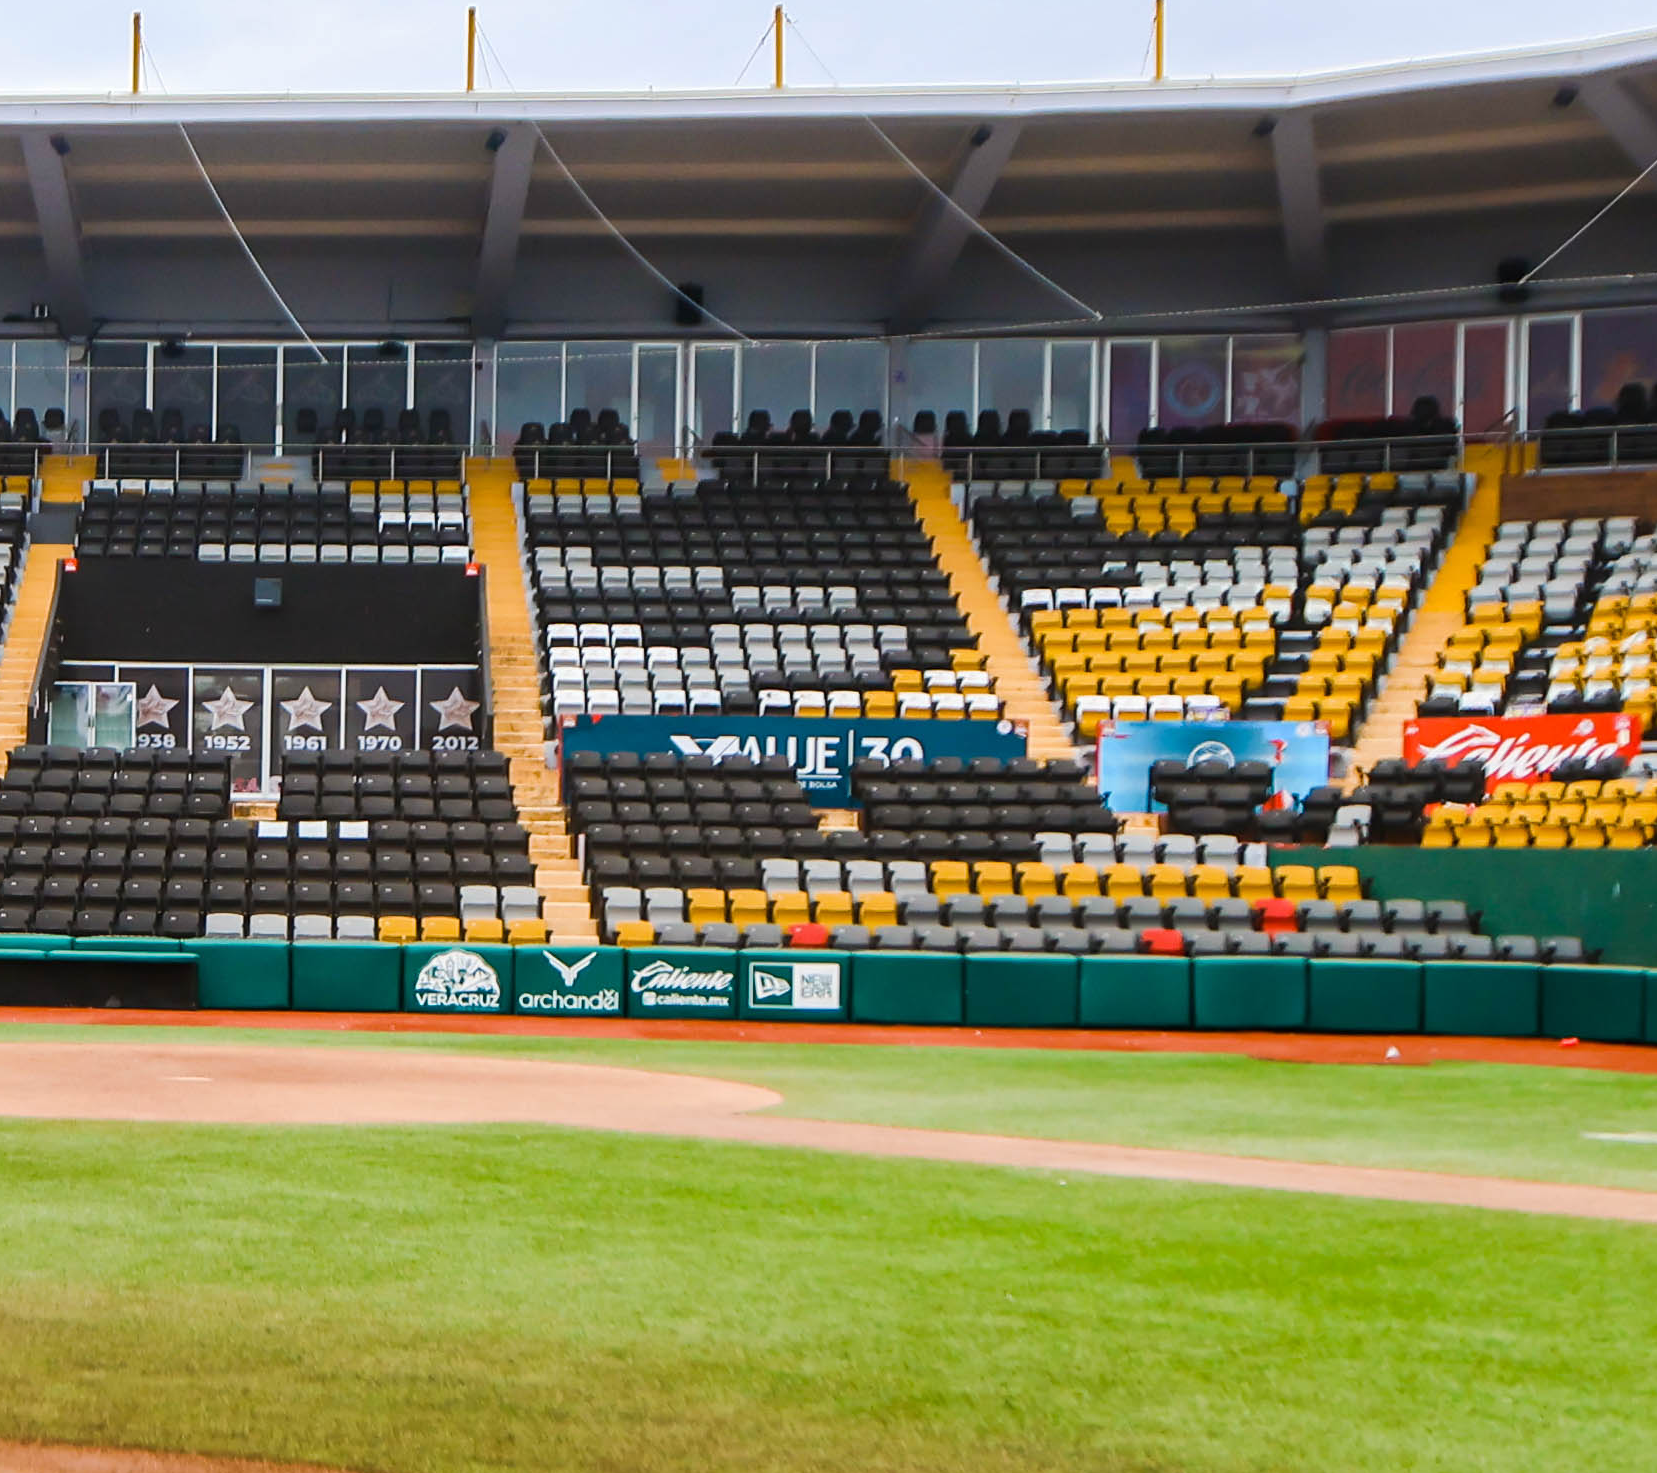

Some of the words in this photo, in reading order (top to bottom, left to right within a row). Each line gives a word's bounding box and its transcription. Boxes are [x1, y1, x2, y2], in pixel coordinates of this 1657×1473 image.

[138, 733, 176, 748] 938
[204, 735, 251, 751] 1952
[284, 734, 326, 750] 1961
[357, 735, 402, 750] 1970
[432, 736, 479, 750] 2012
[631, 960, 734, 992] Caliente
[415, 993, 500, 1007] VERACRUZ
[657, 992, 729, 1007] caliente.mx
